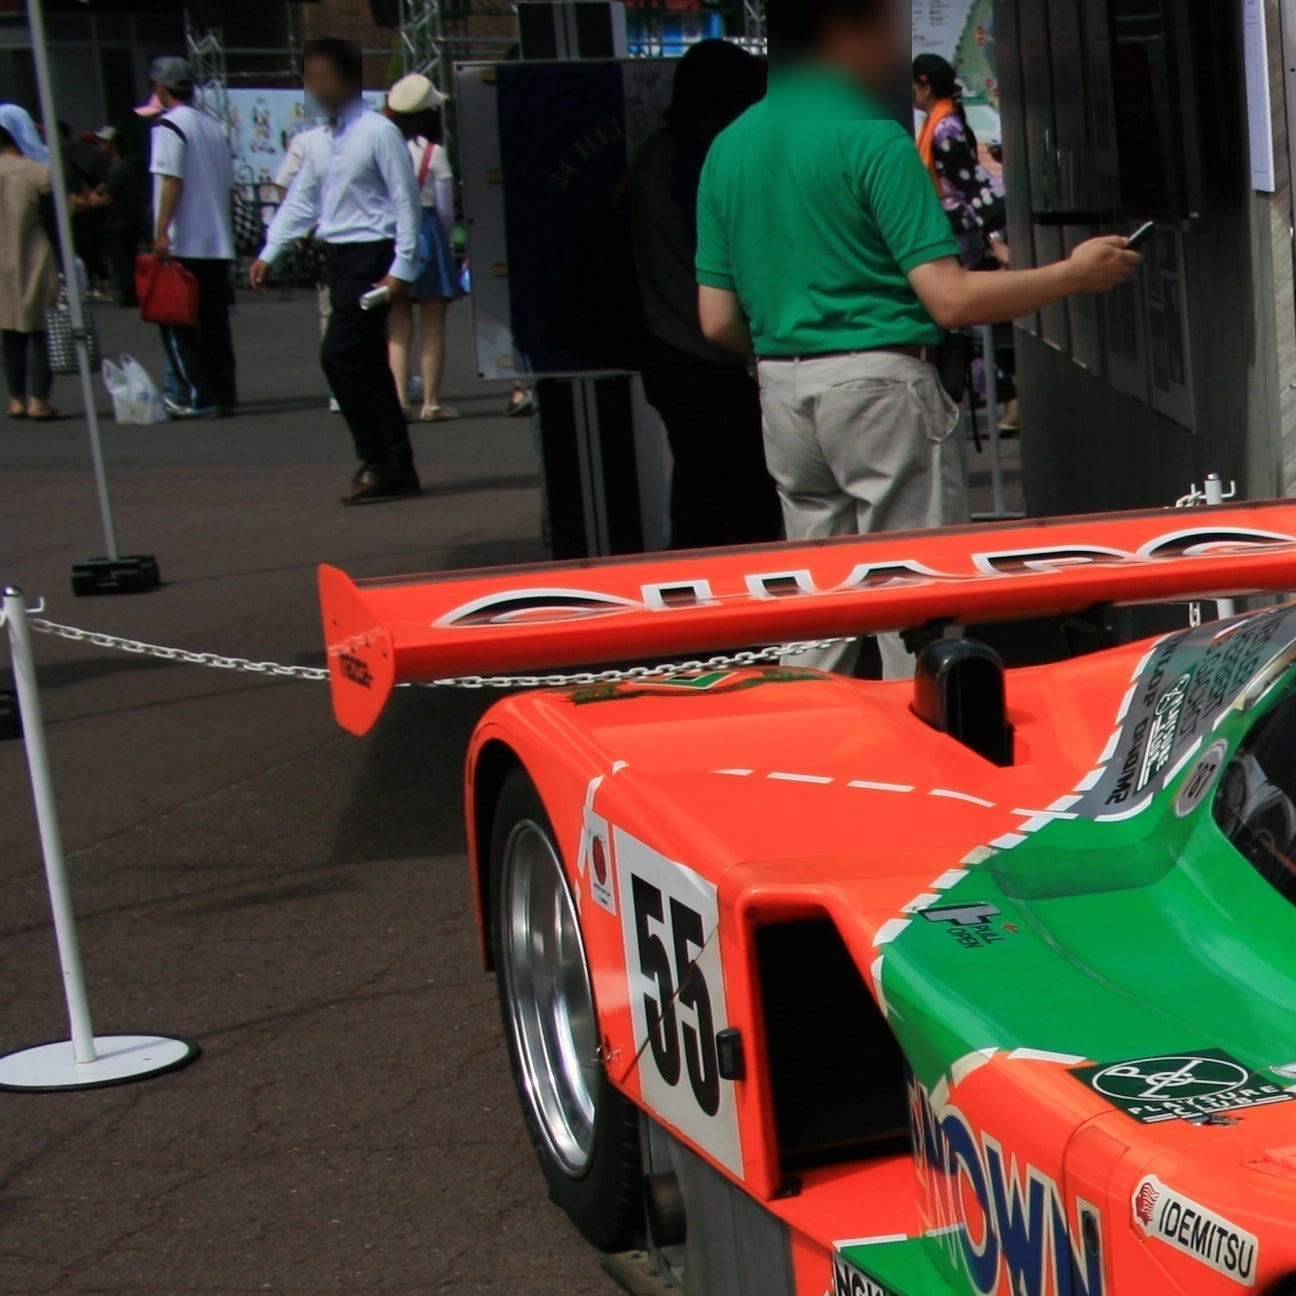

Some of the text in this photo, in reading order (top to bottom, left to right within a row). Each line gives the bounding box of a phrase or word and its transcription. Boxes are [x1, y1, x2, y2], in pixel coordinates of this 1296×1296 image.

[631, 872, 720, 1118] 55
[1128, 1085, 1279, 1114] PLAYSURE
[1173, 1097, 1252, 1116] CLUB
[1159, 1199, 1254, 1278] IDEMITSU
